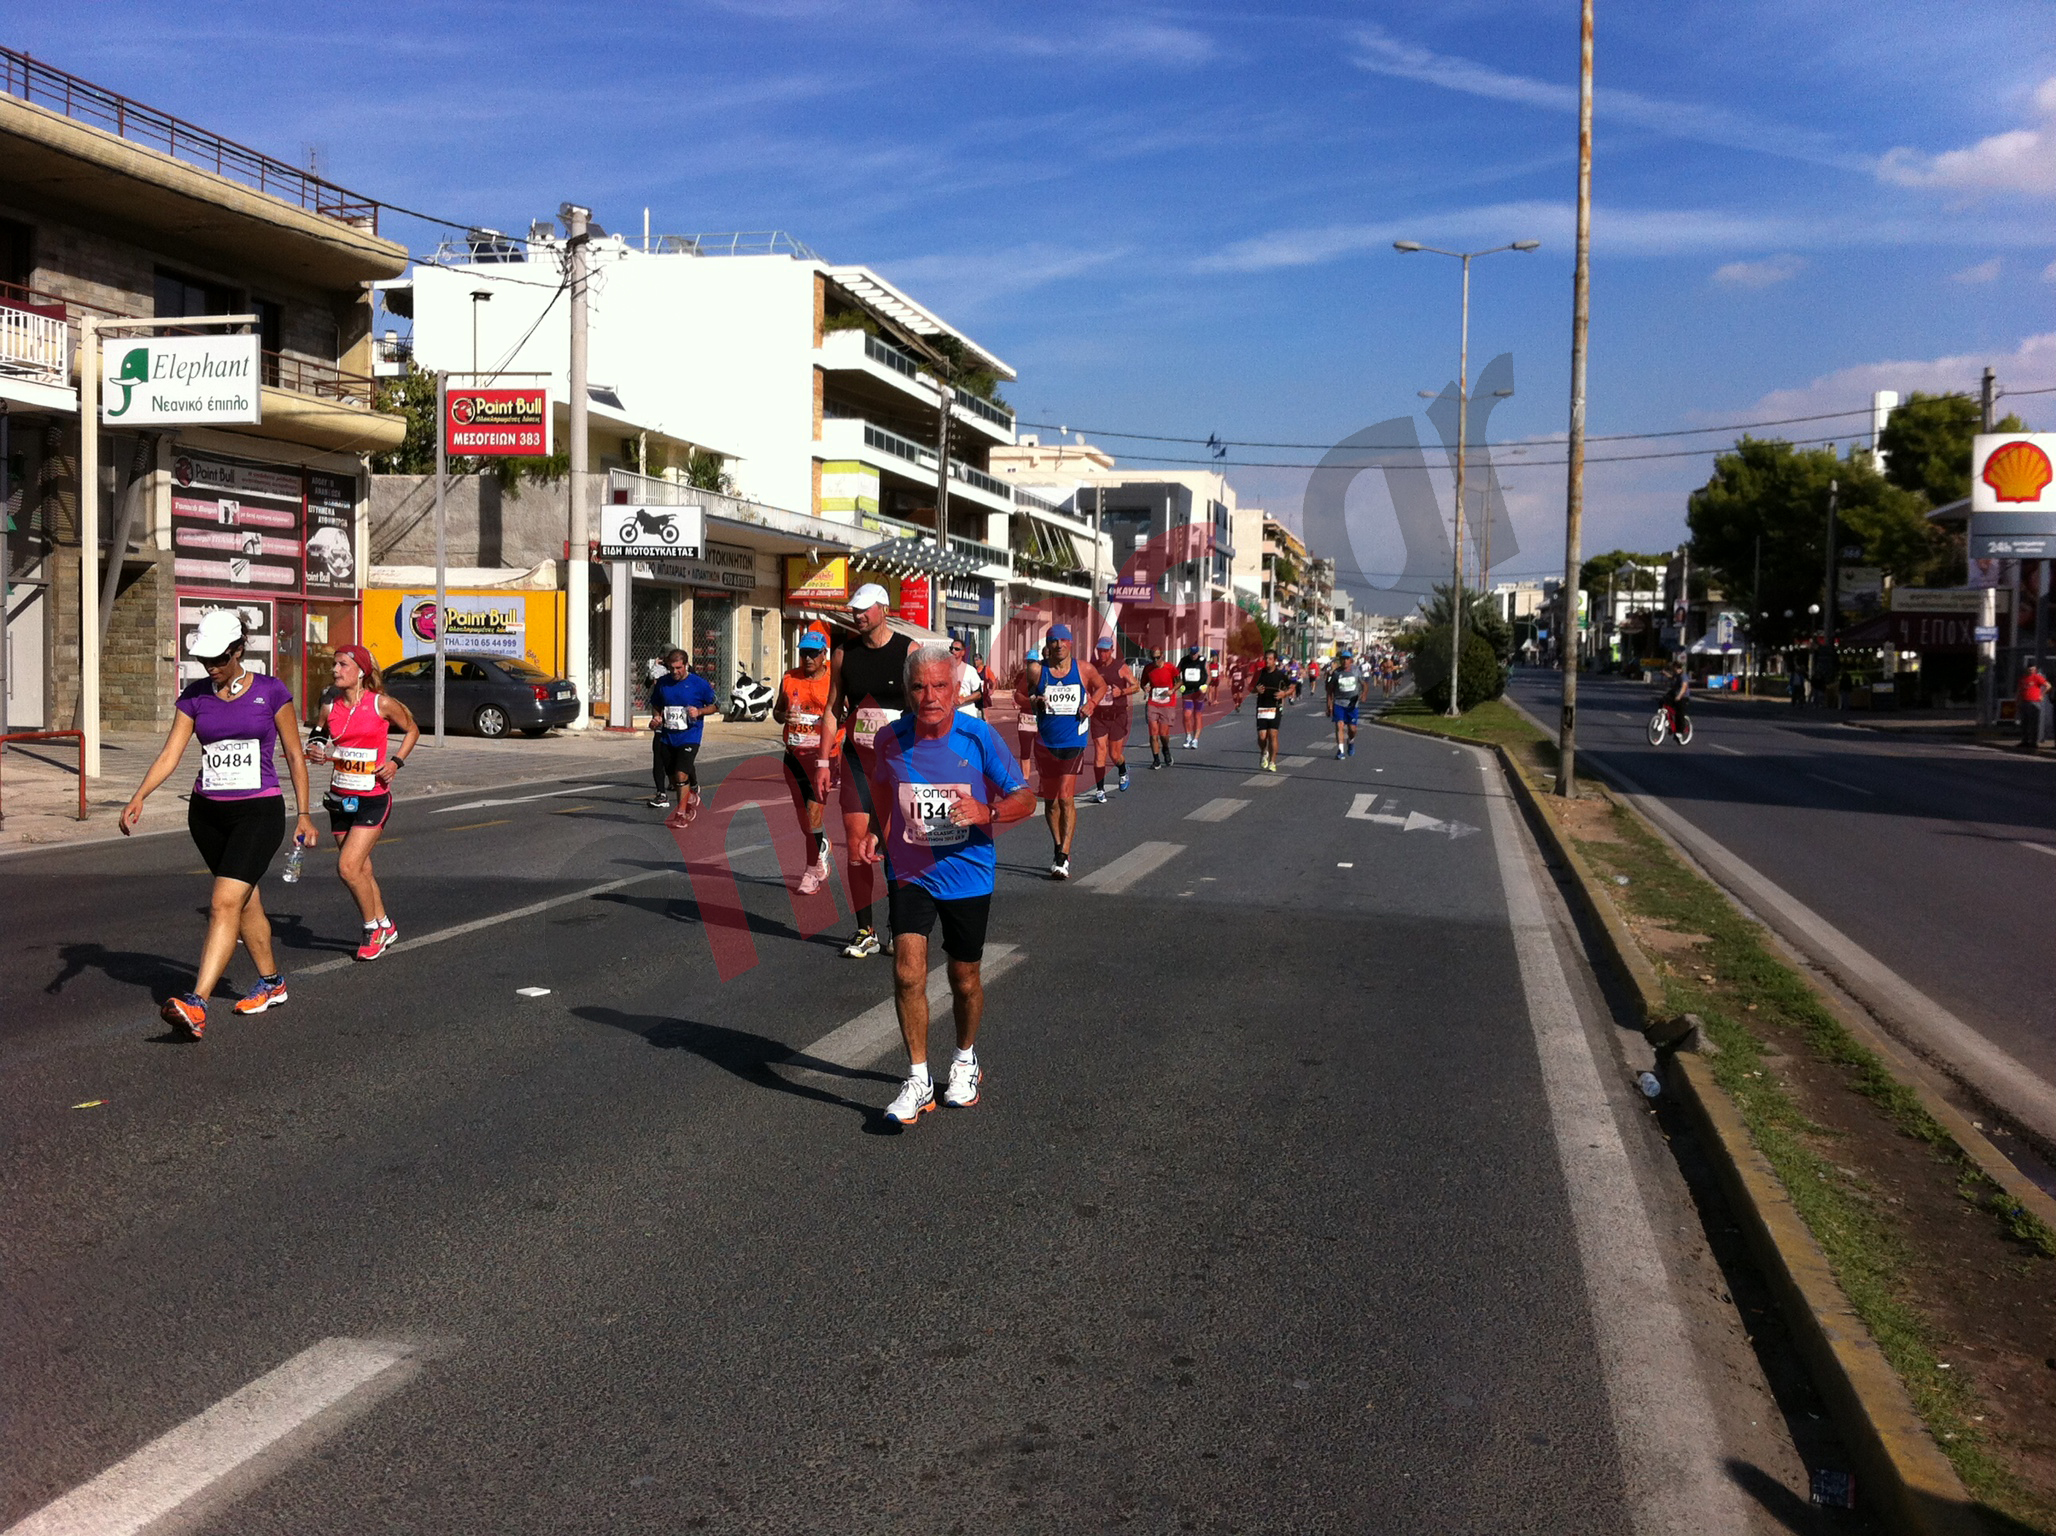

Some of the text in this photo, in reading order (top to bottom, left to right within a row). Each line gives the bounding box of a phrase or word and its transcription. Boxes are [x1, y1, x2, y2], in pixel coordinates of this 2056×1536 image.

[152, 352, 250, 386] Elephant
[152, 395, 249, 412] Νεανικό έπιπλο
[475, 397, 542, 414] Paint Bull
[453, 432, 541, 446] ΜΕΣΟΓΕΙΩΝ 383
[195, 465, 219, 481] Paint
[219, 468, 235, 484] Bull
[602, 546, 622, 555] ΕΙΔΗ
[946, 579, 980, 601] ΚΑΥΚΑΣ
[1115, 586, 1152, 597] ΚΑΥΚΑΣ
[447, 608, 517, 626] Paint Bull
[465, 638, 479, 646] 210
[481, 639, 491, 647] 65
[1048, 693, 1077, 703] 10996
[207, 753, 253, 768] 10484
[910, 802, 951, 820] 1134
